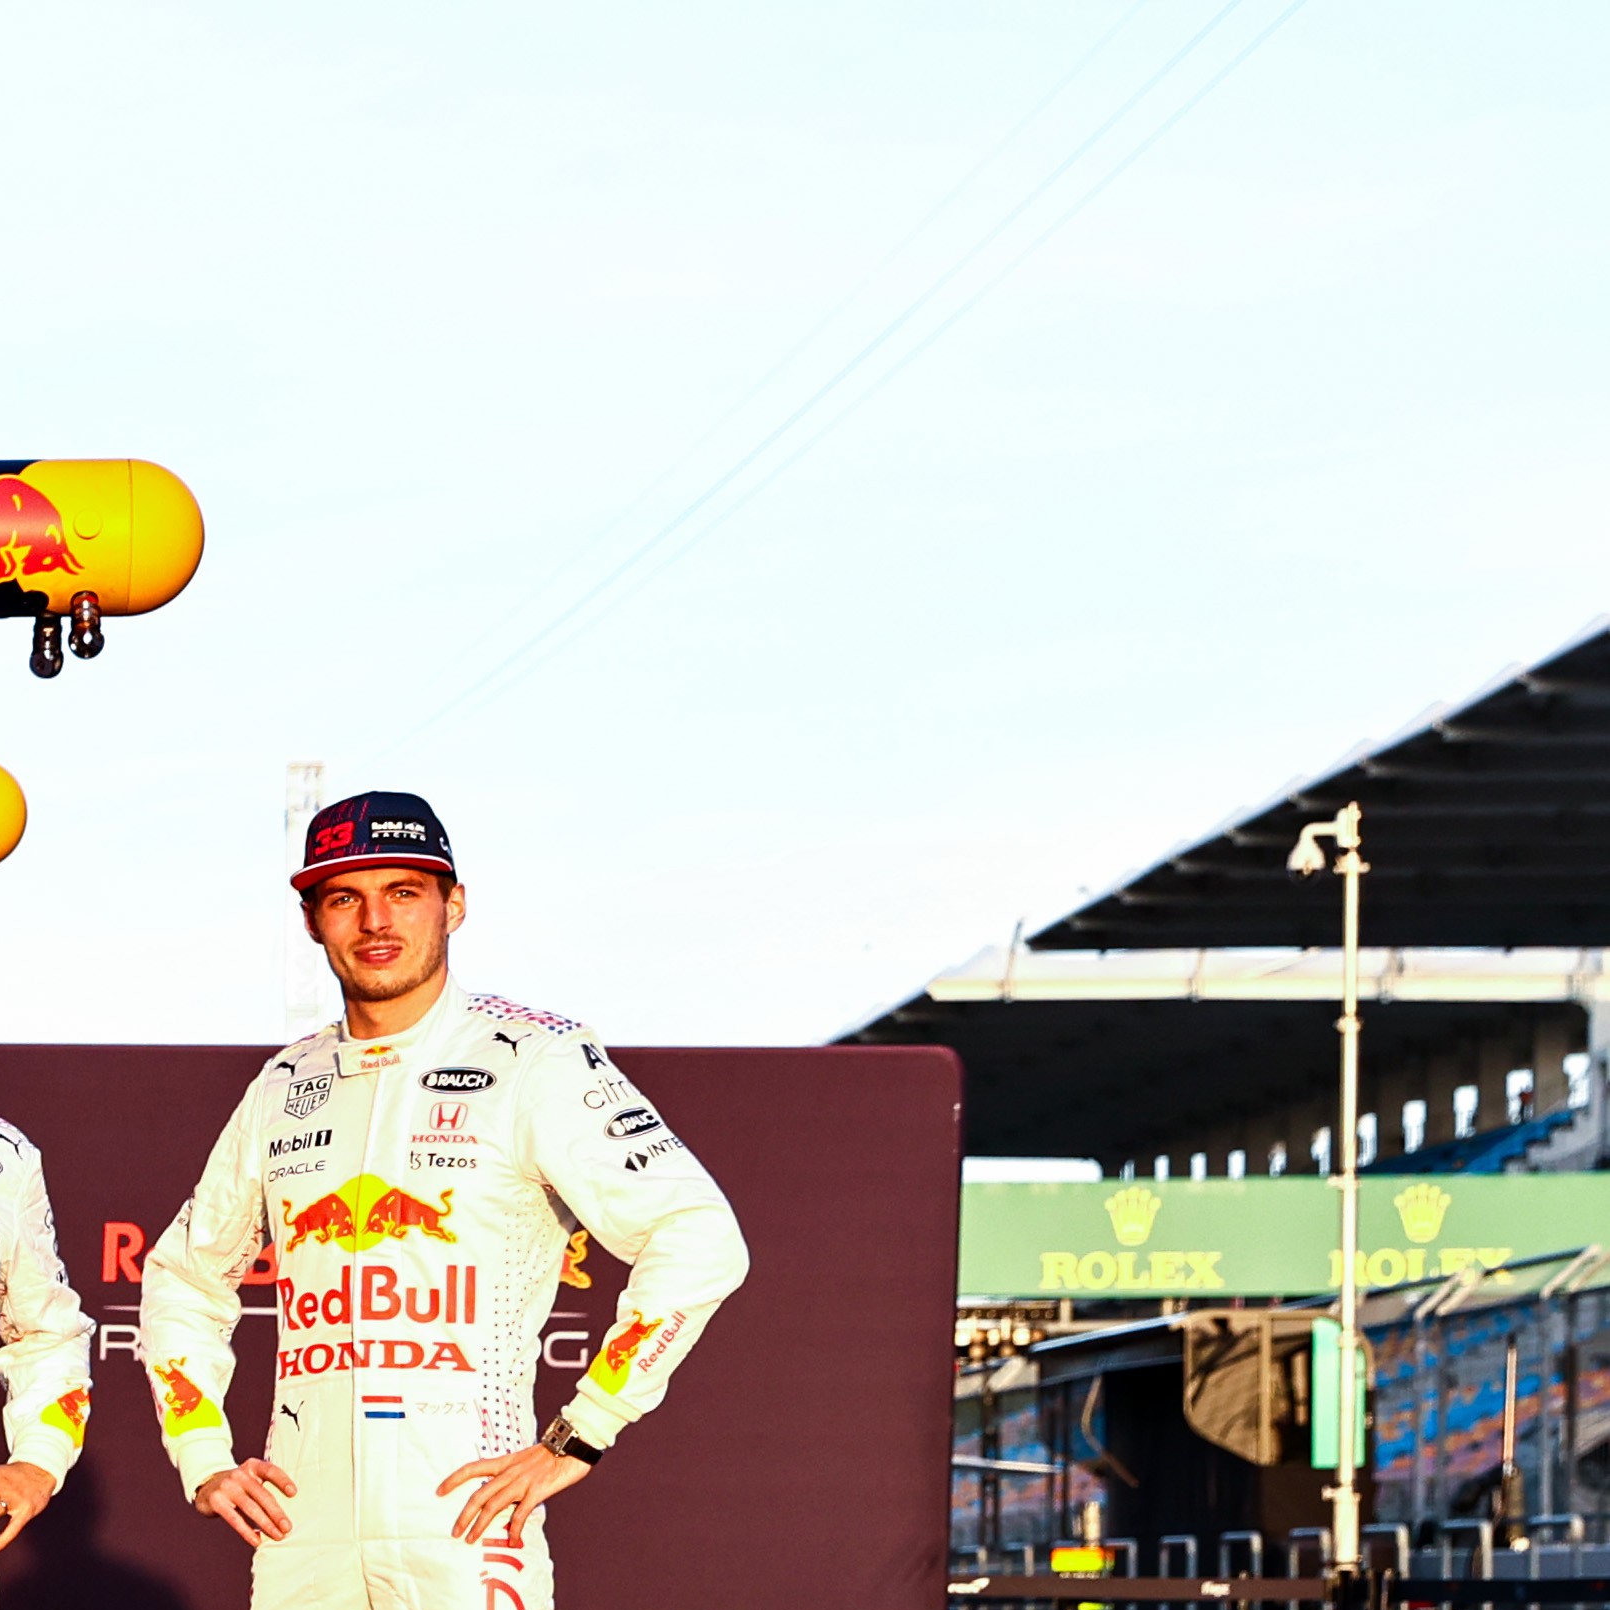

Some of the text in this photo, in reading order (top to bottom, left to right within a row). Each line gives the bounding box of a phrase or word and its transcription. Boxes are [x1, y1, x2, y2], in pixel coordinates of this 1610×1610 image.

[314, 821, 356, 857] 33
[292, 1078, 330, 1098] TAG
[437, 1074, 488, 1088] RAUCH
[286, 1091, 328, 1117] HEUER
[621, 1112, 656, 1131] RAUC
[268, 1132, 312, 1159] Mobil
[411, 1134, 478, 1144] HONDA
[647, 1137, 684, 1158] INTE
[268, 1160, 325, 1183] ORACLE
[427, 1153, 478, 1169] Tezos
[1039, 1251, 1225, 1290] ROLEX
[276, 1264, 476, 1333] Red Bull
[638, 1311, 688, 1373] Red Bull
[277, 1339, 477, 1381] HONDA
